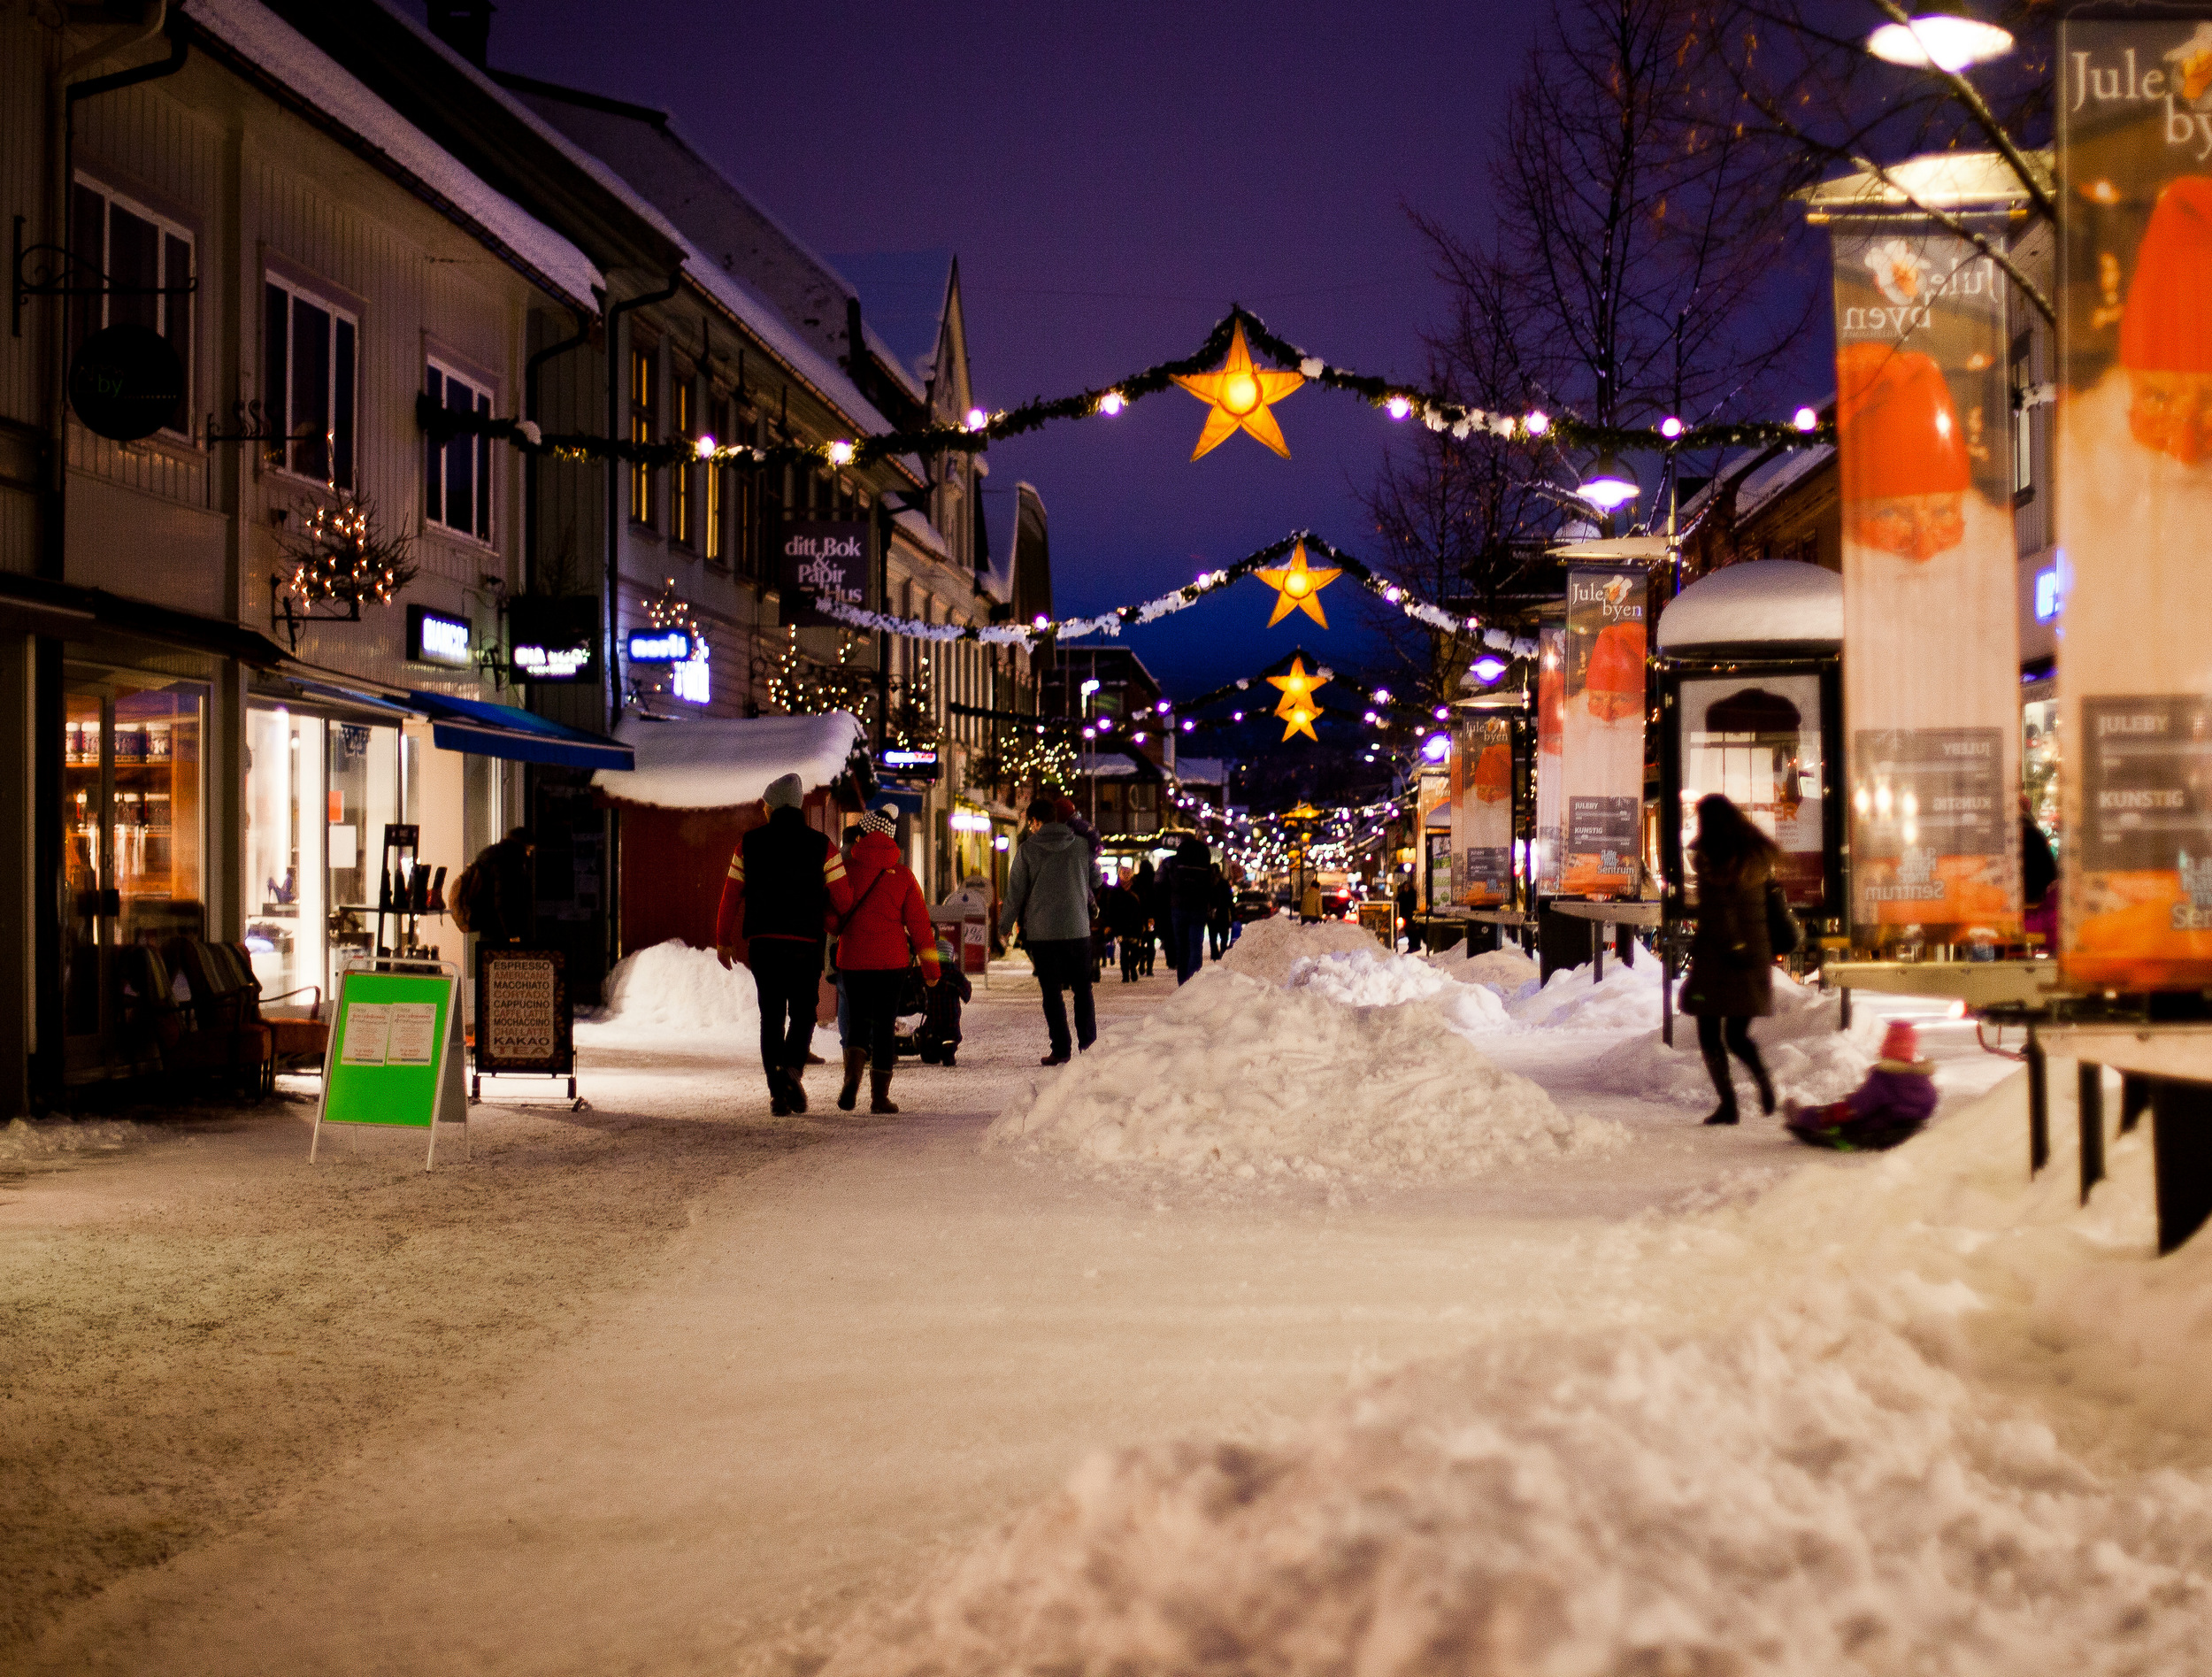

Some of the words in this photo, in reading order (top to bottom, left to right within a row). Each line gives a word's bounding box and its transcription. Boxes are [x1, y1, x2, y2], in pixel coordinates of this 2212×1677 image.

[2070, 47, 2167, 113] Jule
[784, 535, 816, 557] ditt
[823, 536, 862, 558] Bok
[797, 564, 846, 589] Papir
[825, 584, 863, 603] Hus
[1572, 582, 1604, 605] Jule
[1602, 598, 1642, 621] byen
[1466, 721, 1486, 734] Jule
[2097, 714, 2168, 736] JULEBY
[1484, 731, 1509, 744] byen
[2099, 790, 2185, 809] KUNSTIG
[1597, 864, 1635, 874] Sentrum
[494, 961, 549, 971] ESPRESSO
[494, 1000, 549, 1009] CAPPUCINO
